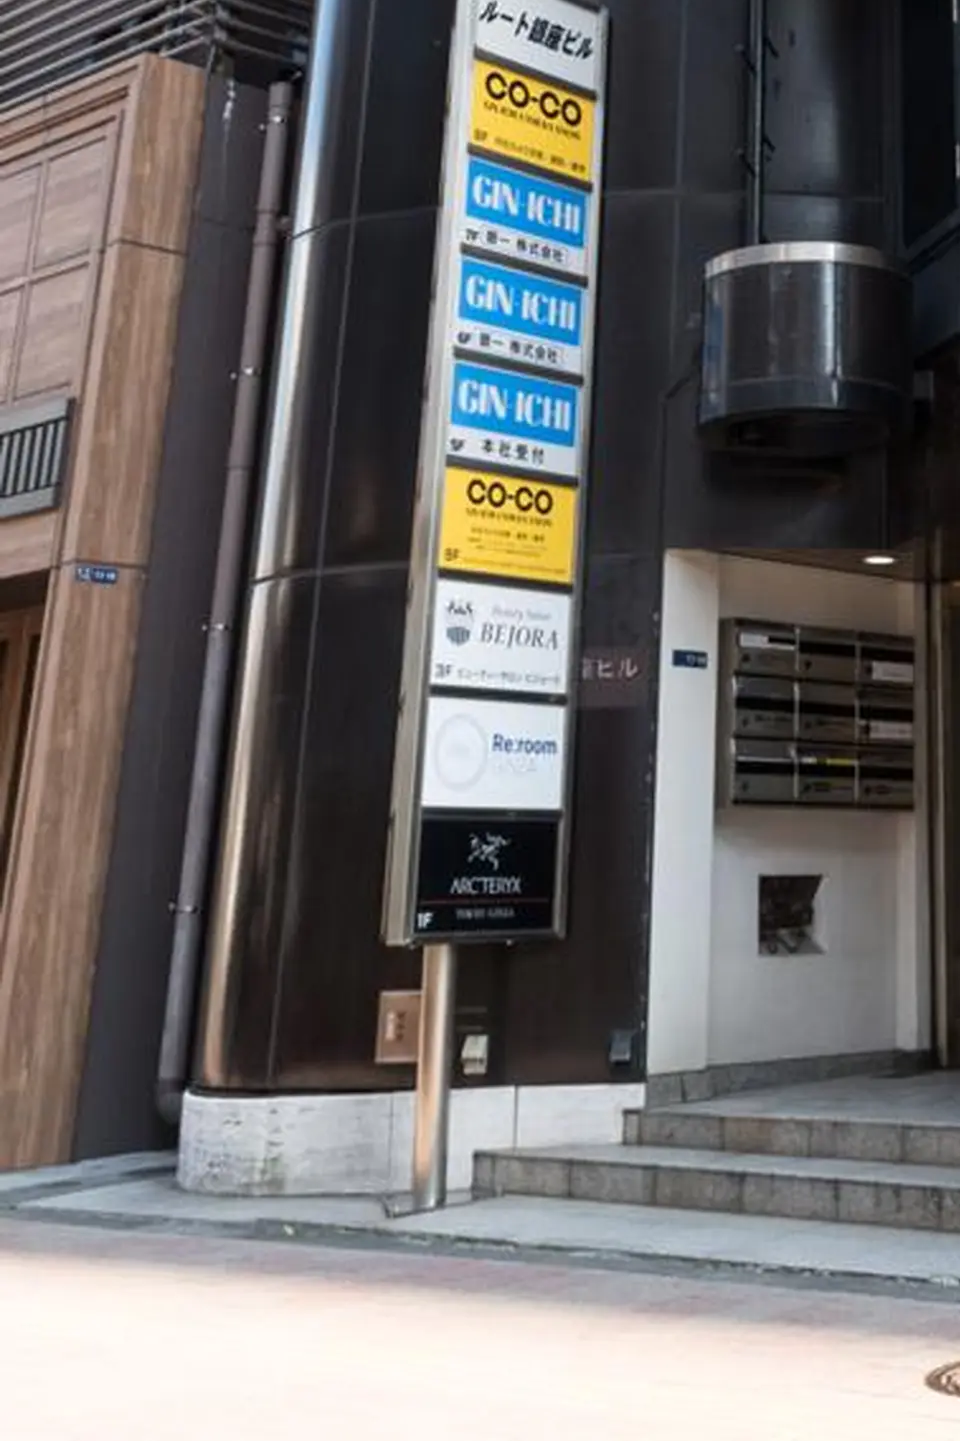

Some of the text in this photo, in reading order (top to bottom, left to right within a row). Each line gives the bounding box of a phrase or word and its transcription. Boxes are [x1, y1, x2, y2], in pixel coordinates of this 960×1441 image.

[479, 0, 593, 59] ルート銀座ビル
[485, 71, 582, 127] CO-CO
[467, 479, 553, 515] CO-CO
[480, 621, 558, 651] BEJORA
